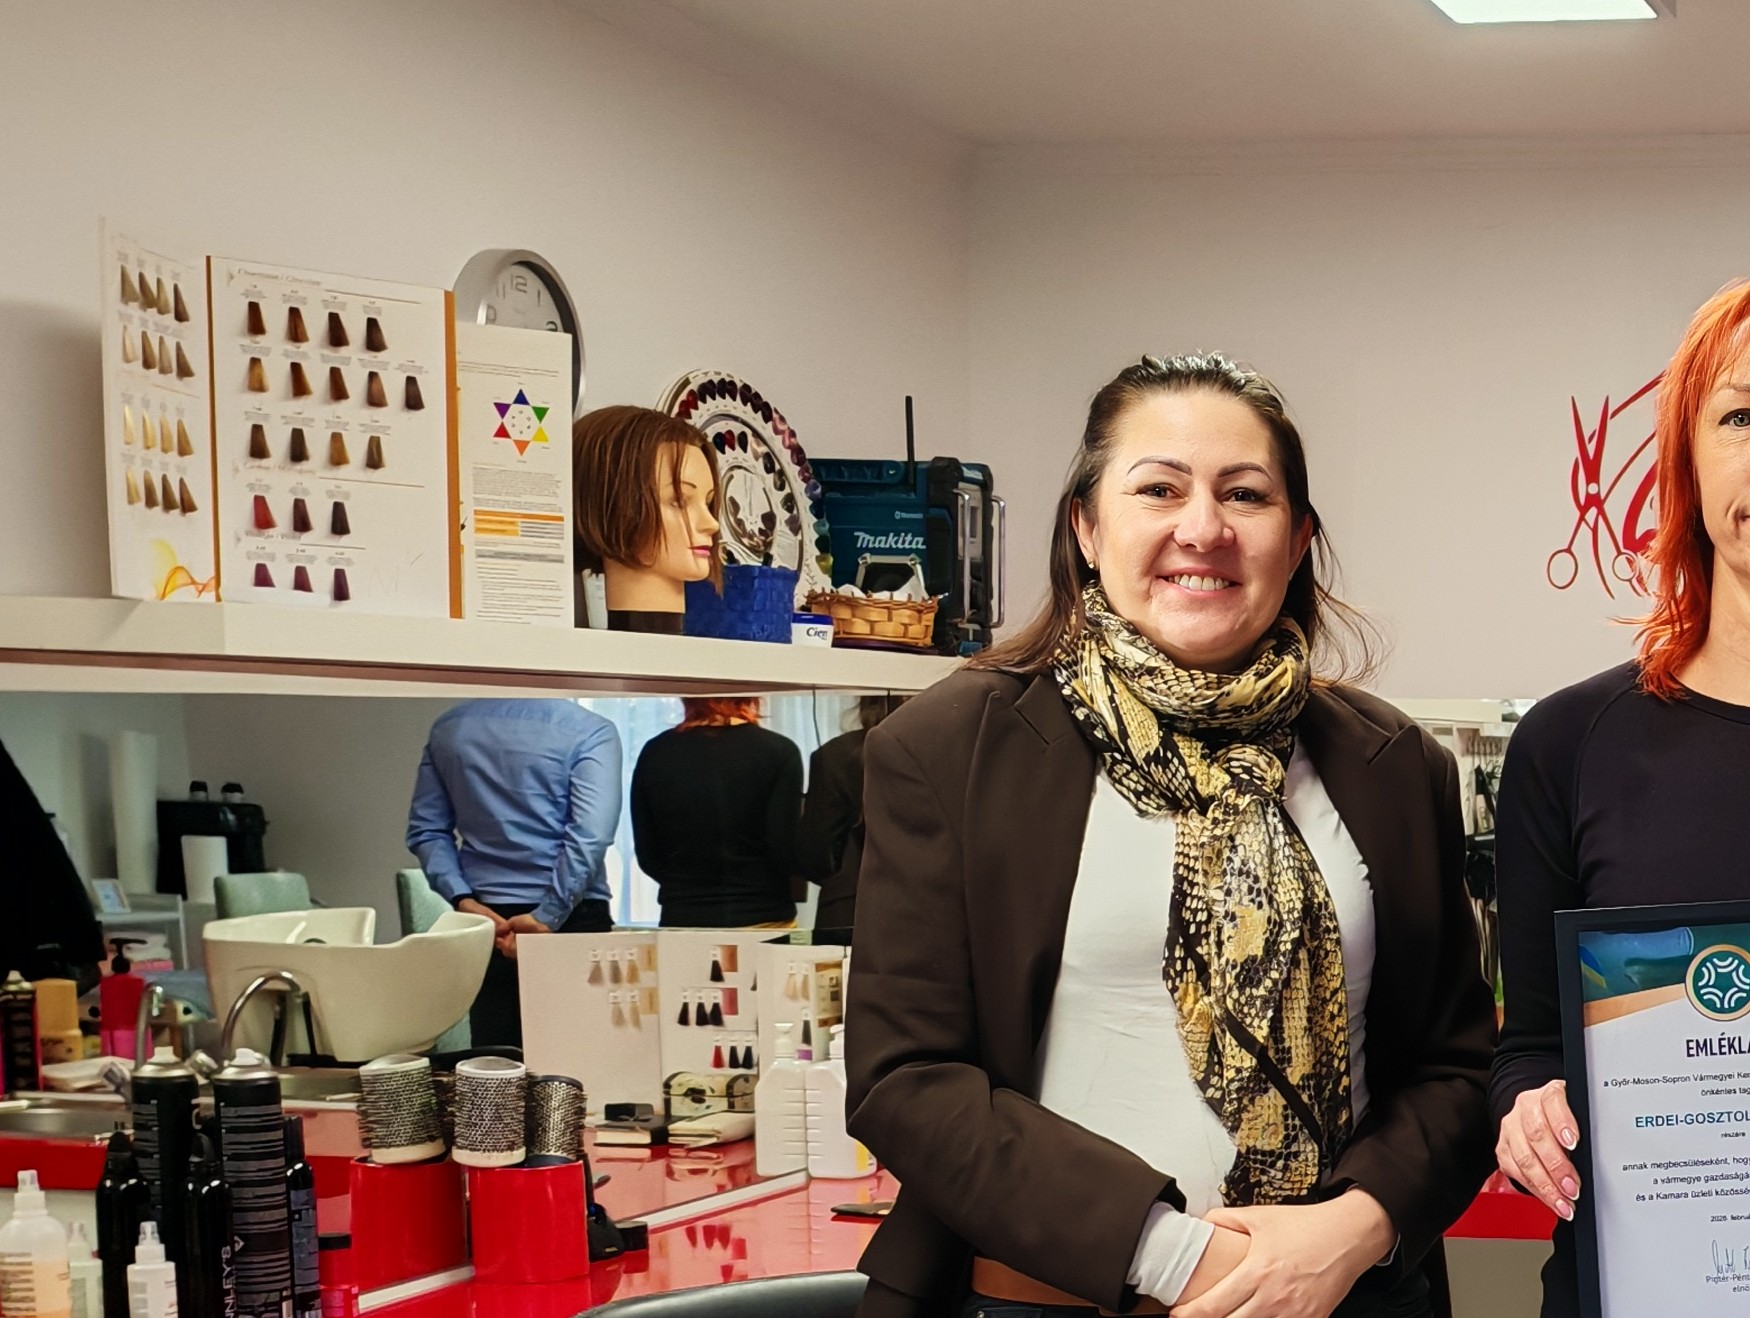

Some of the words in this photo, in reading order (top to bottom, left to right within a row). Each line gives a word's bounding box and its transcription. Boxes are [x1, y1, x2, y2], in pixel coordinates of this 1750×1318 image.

[510, 274, 528, 293] 12
[1692, 1072, 1735, 1082] Vármegyei
[1622, 1162, 1648, 1171] annak
[1660, 1175, 1701, 1185] vármegye
[1656, 1192, 1689, 1200] Kamara
